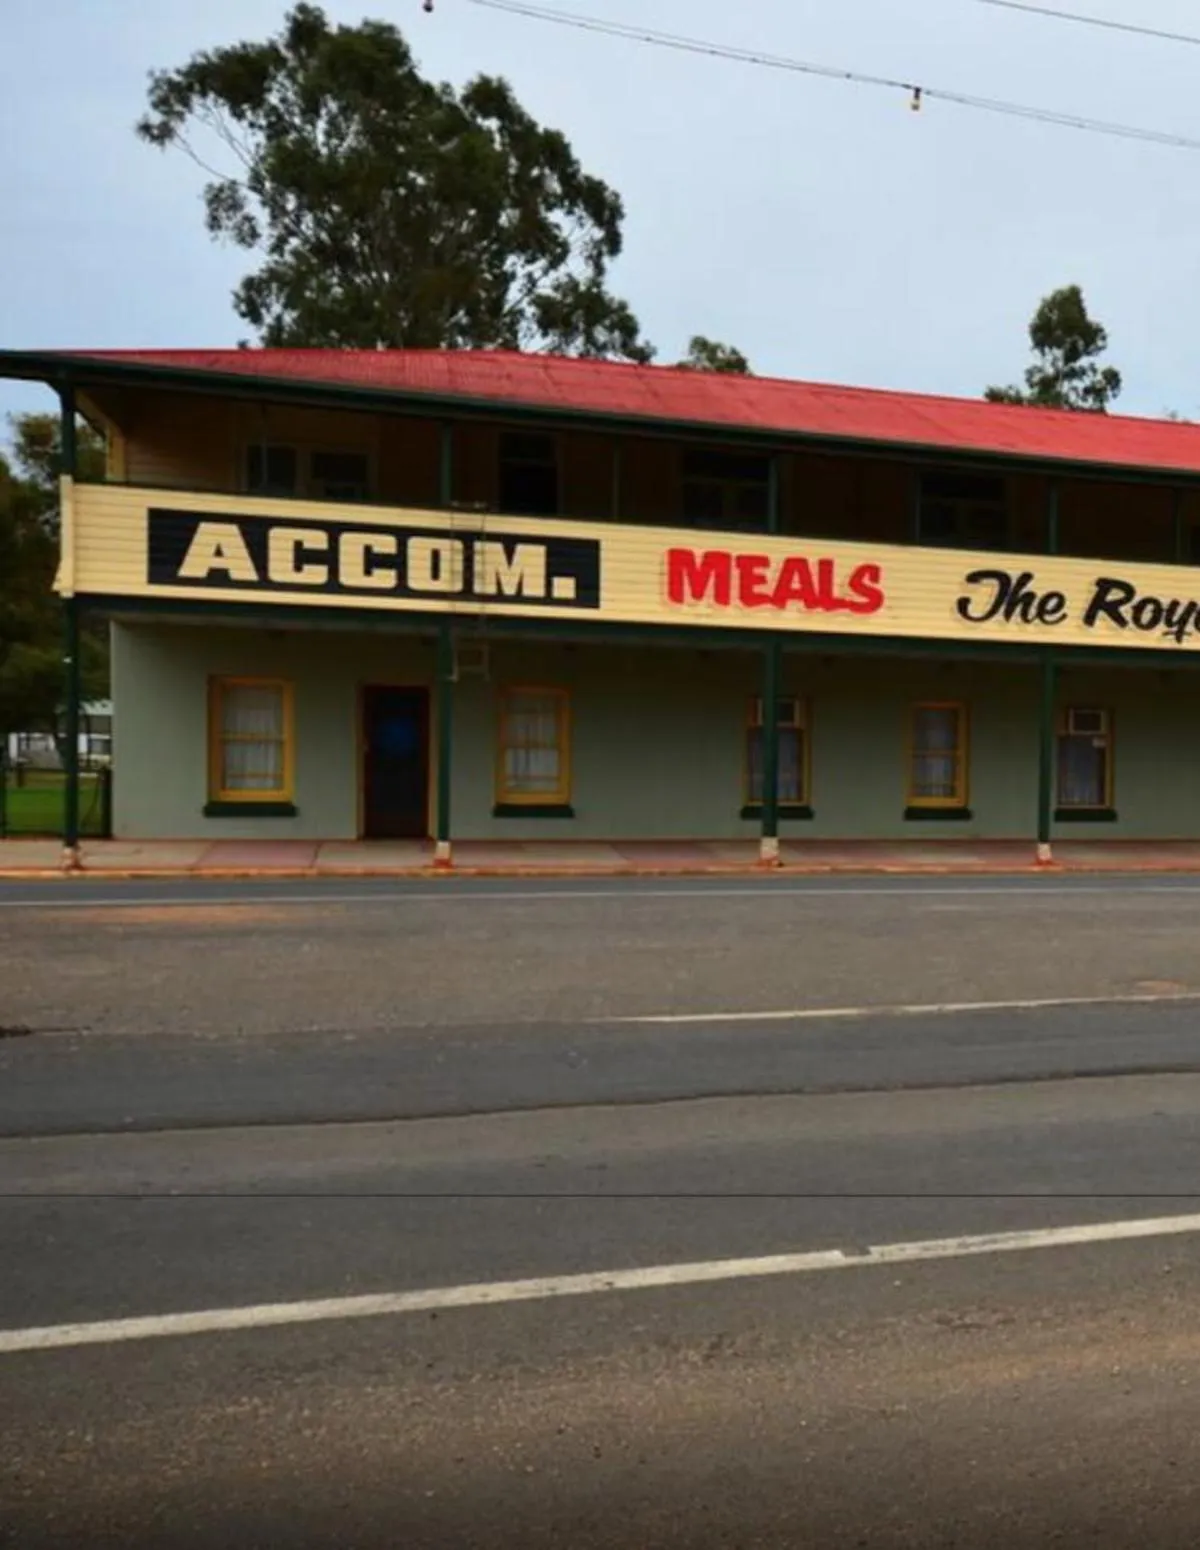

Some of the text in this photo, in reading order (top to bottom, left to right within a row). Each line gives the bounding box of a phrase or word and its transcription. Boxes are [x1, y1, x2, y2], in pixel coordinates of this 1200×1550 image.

[178, 521, 577, 599] ACCOM.
[665, 547, 886, 615] MEALS
[956, 569, 1069, 626] The
